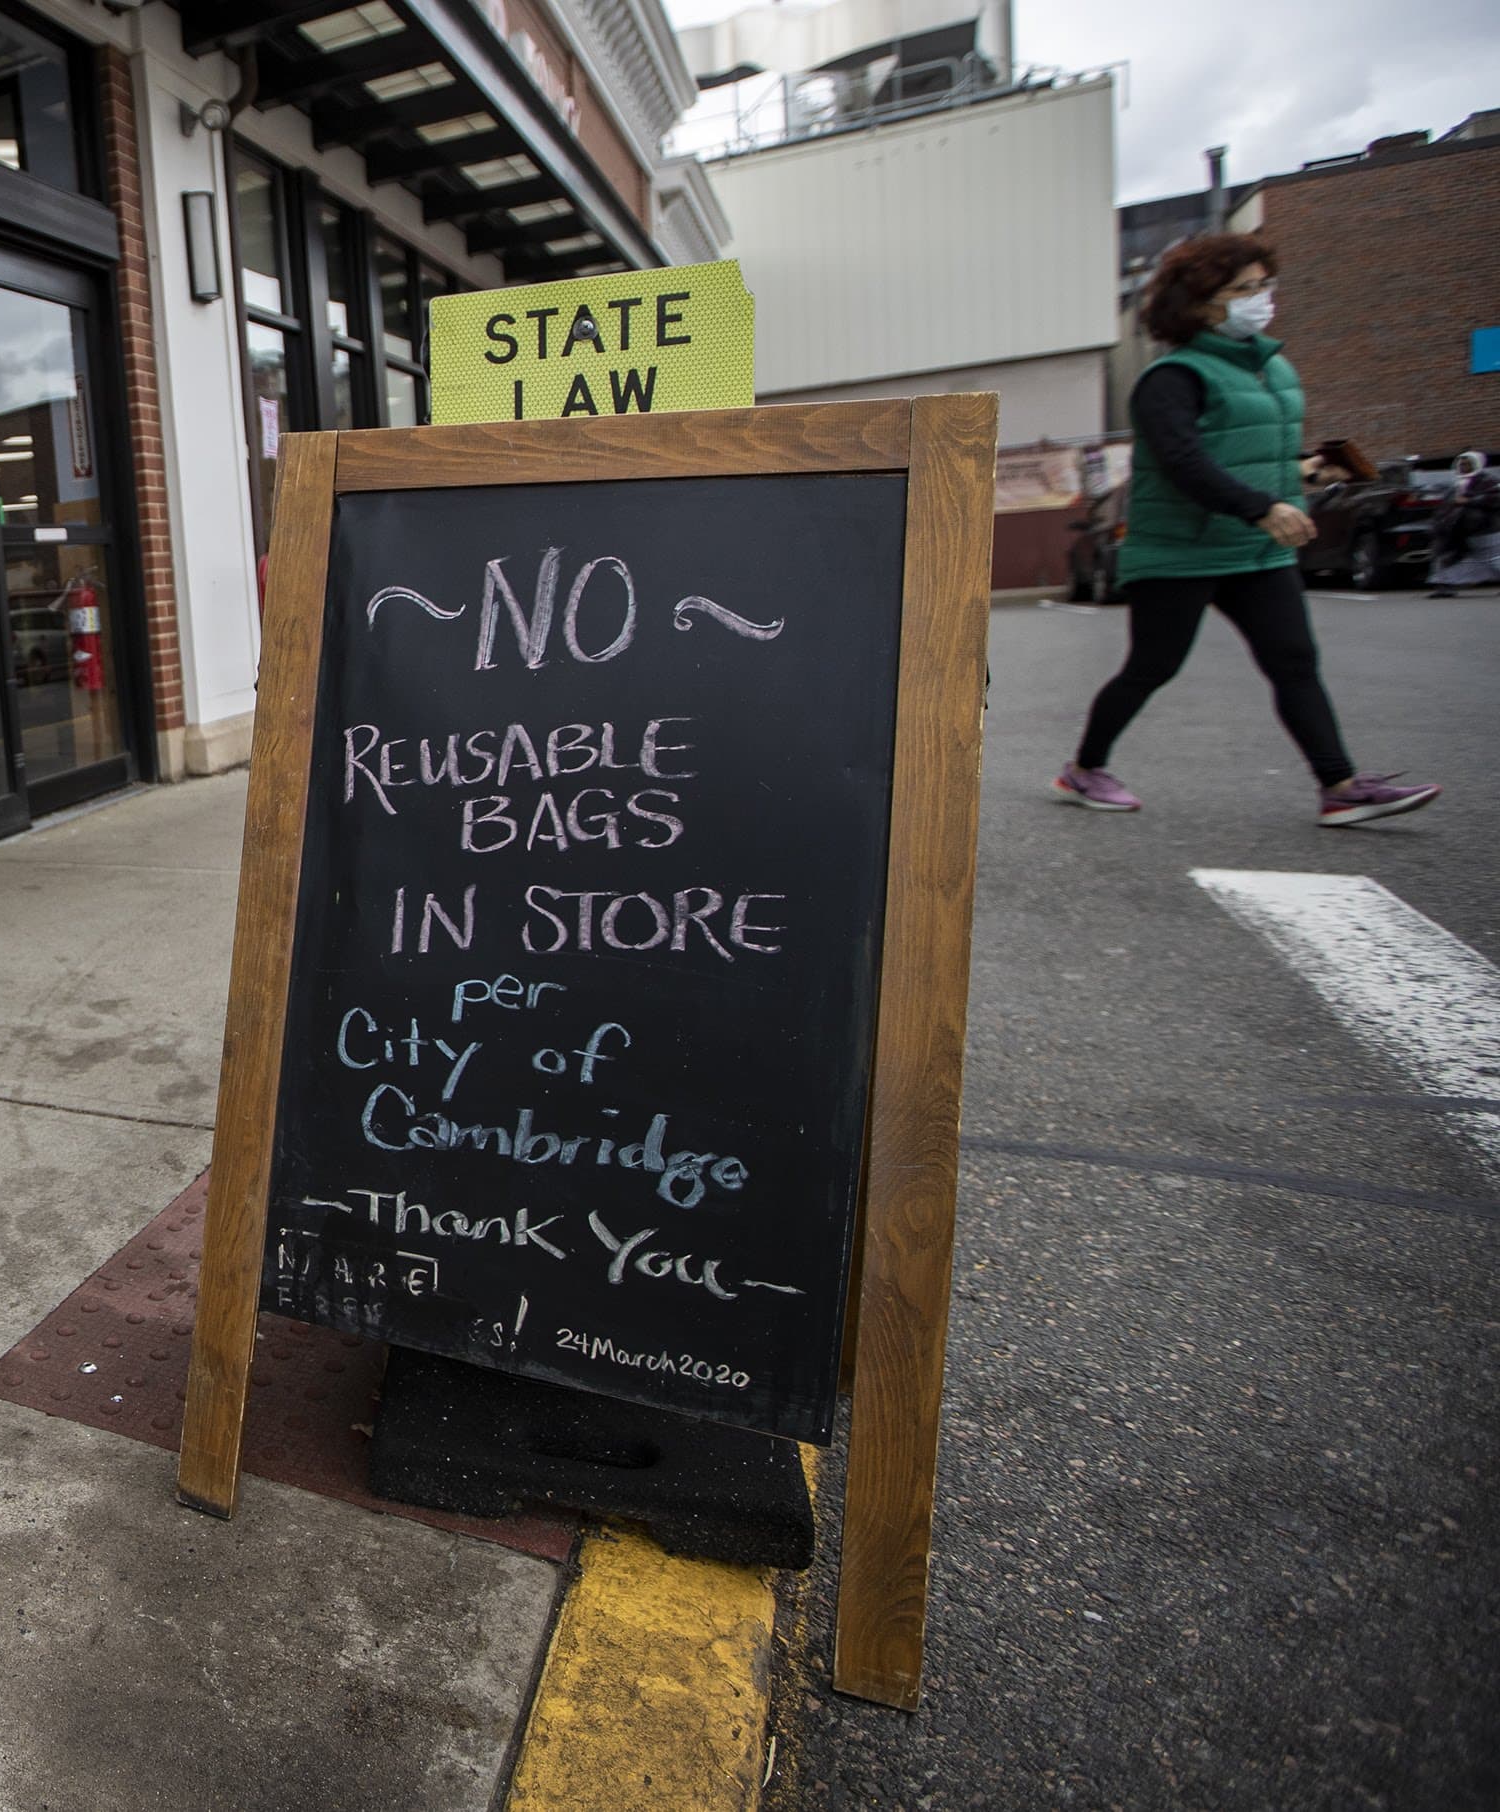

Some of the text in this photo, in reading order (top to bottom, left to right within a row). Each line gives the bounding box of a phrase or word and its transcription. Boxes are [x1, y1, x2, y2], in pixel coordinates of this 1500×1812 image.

[484, 291, 692, 364] STATE
[474, 546, 637, 670] NO
[344, 717, 698, 815] REUSABLE
[460, 788, 684, 853] BAGS
[391, 884, 787, 962] IN STORE
[452, 974, 568, 1023] per
[338, 1007, 632, 1101] City of
[361, 1083, 749, 1208] Cambridge
[347, 1189, 738, 1300] Thank You
